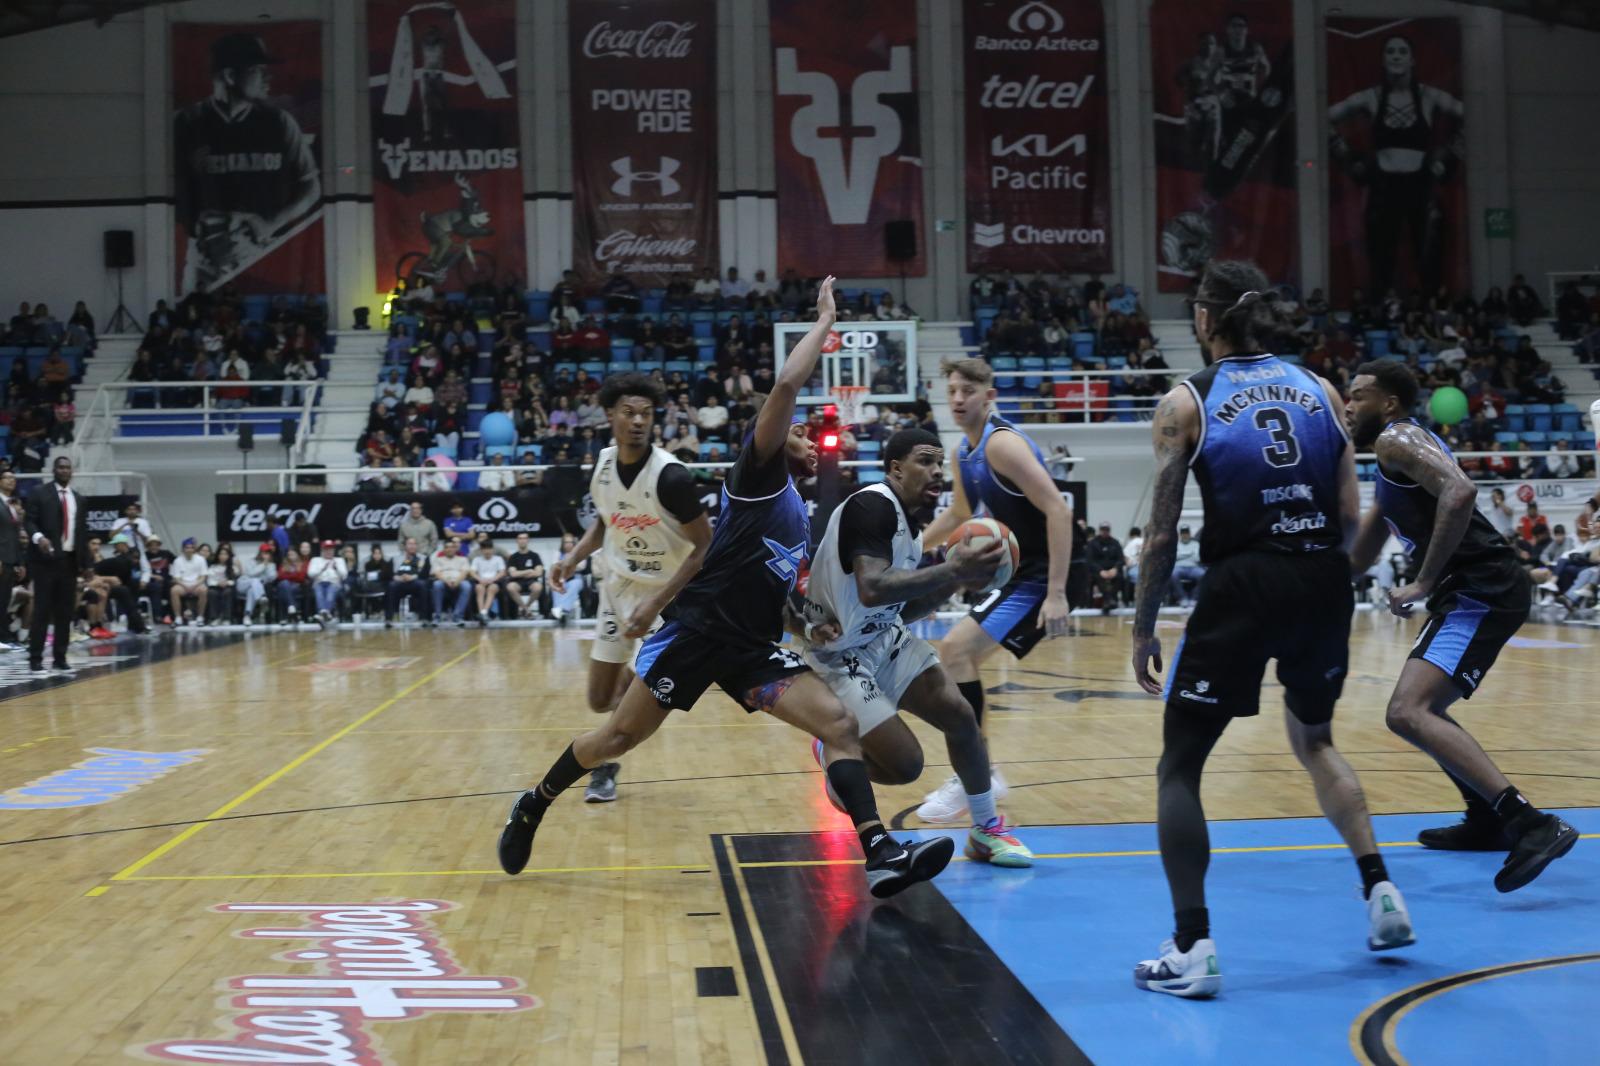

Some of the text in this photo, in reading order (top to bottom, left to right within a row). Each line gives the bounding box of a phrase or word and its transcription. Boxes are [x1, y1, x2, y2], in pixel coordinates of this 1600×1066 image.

[583, 20, 697, 58] Coca-Cola
[975, 35, 1099, 51] Banco Azteca
[591, 89, 691, 110] POWER
[980, 74, 1095, 108] telcel
[638, 111, 692, 132] ADE
[991, 134, 1087, 157] KIA
[991, 165, 1088, 189] Pacific
[595, 230, 697, 260] Caliente
[1011, 224, 1105, 244] Chevron
[1214, 384, 1324, 426] MCKINNEY
[1253, 406, 1302, 469] 3
[496, 521, 541, 532] Azteca
[218, 900, 530, 1020] Huichol
